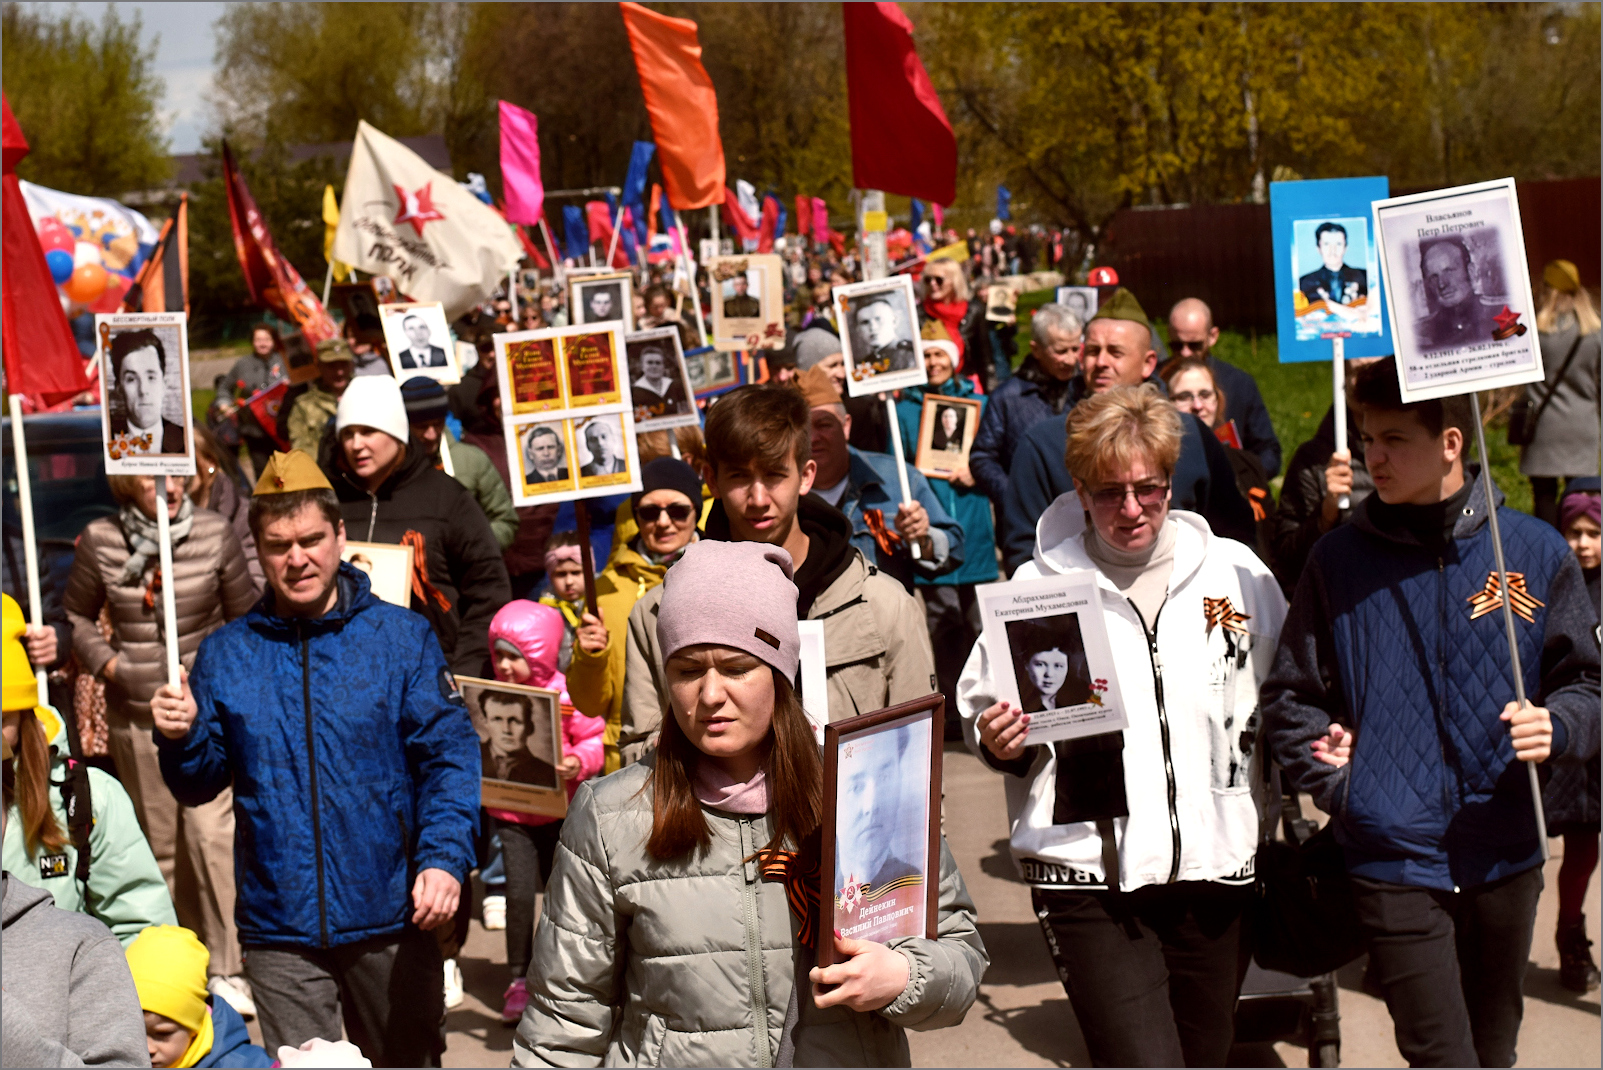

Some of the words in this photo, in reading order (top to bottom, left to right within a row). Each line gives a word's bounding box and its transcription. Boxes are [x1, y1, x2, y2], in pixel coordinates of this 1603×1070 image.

[1426, 209, 1472, 224] Власьянов
[1417, 227, 1440, 239] Петр
[1442, 220, 1485, 234] Петрович
[1012, 590, 1067, 605] Абдрахманова
[994, 606, 1034, 617] Екатерина
[1035, 599, 1089, 613] Мухамедовна
[859, 898, 897, 920] Дейнекин
[840, 920, 873, 937] Василий
